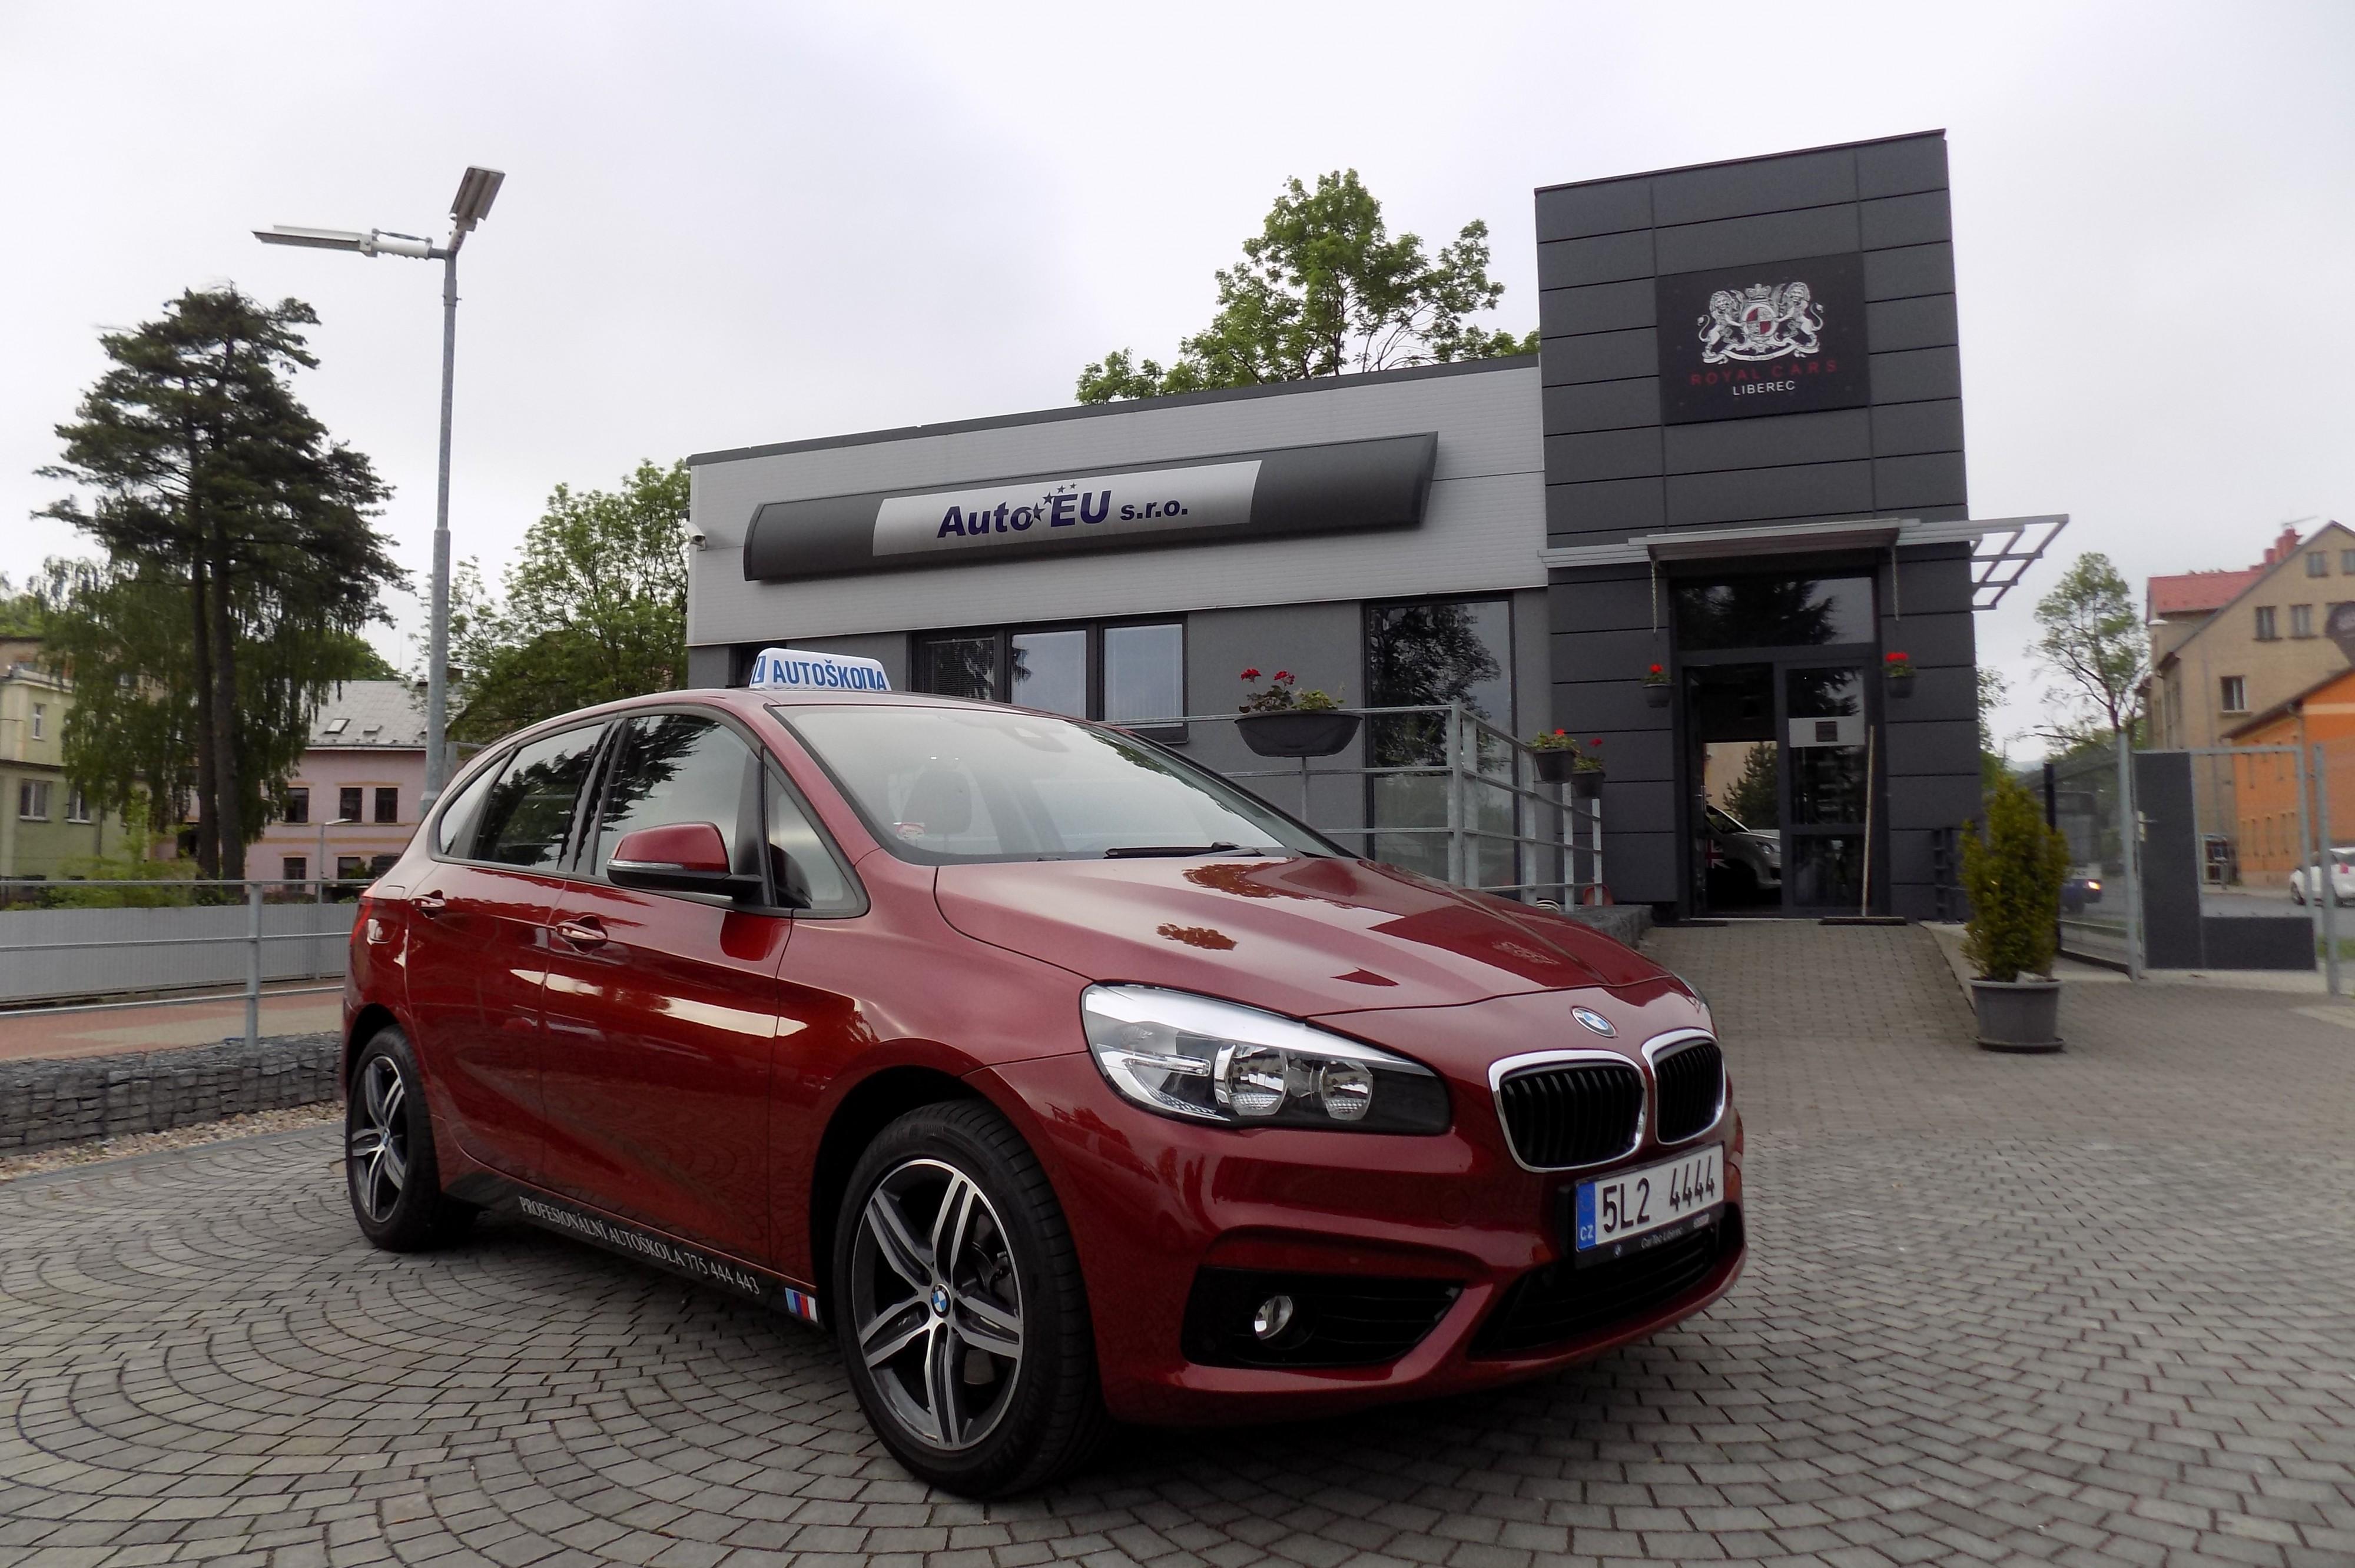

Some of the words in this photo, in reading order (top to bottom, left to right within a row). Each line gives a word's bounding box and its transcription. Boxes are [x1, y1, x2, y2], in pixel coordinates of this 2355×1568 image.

[1689, 366, 1762, 386] ROYAL
[1771, 360, 1838, 377] CARS
[1732, 380, 1796, 396] LIBEREC
[1120, 500, 1188, 521] s.r.o.
[773, 659, 887, 690] AUTOŠKOLA
[1603, 1177, 1650, 1233] 5L2
[1670, 1155, 1715, 1212] 4444
[519, 1196, 608, 1240] PROFESIONÁLNÍ
[609, 1227, 686, 1267] AUTOŠKOLA
[684, 1253, 708, 1274] 775
[711, 1262, 734, 1284] 444
[737, 1271, 759, 1294] 443
[1580, 1225, 1593, 1241] CZ
